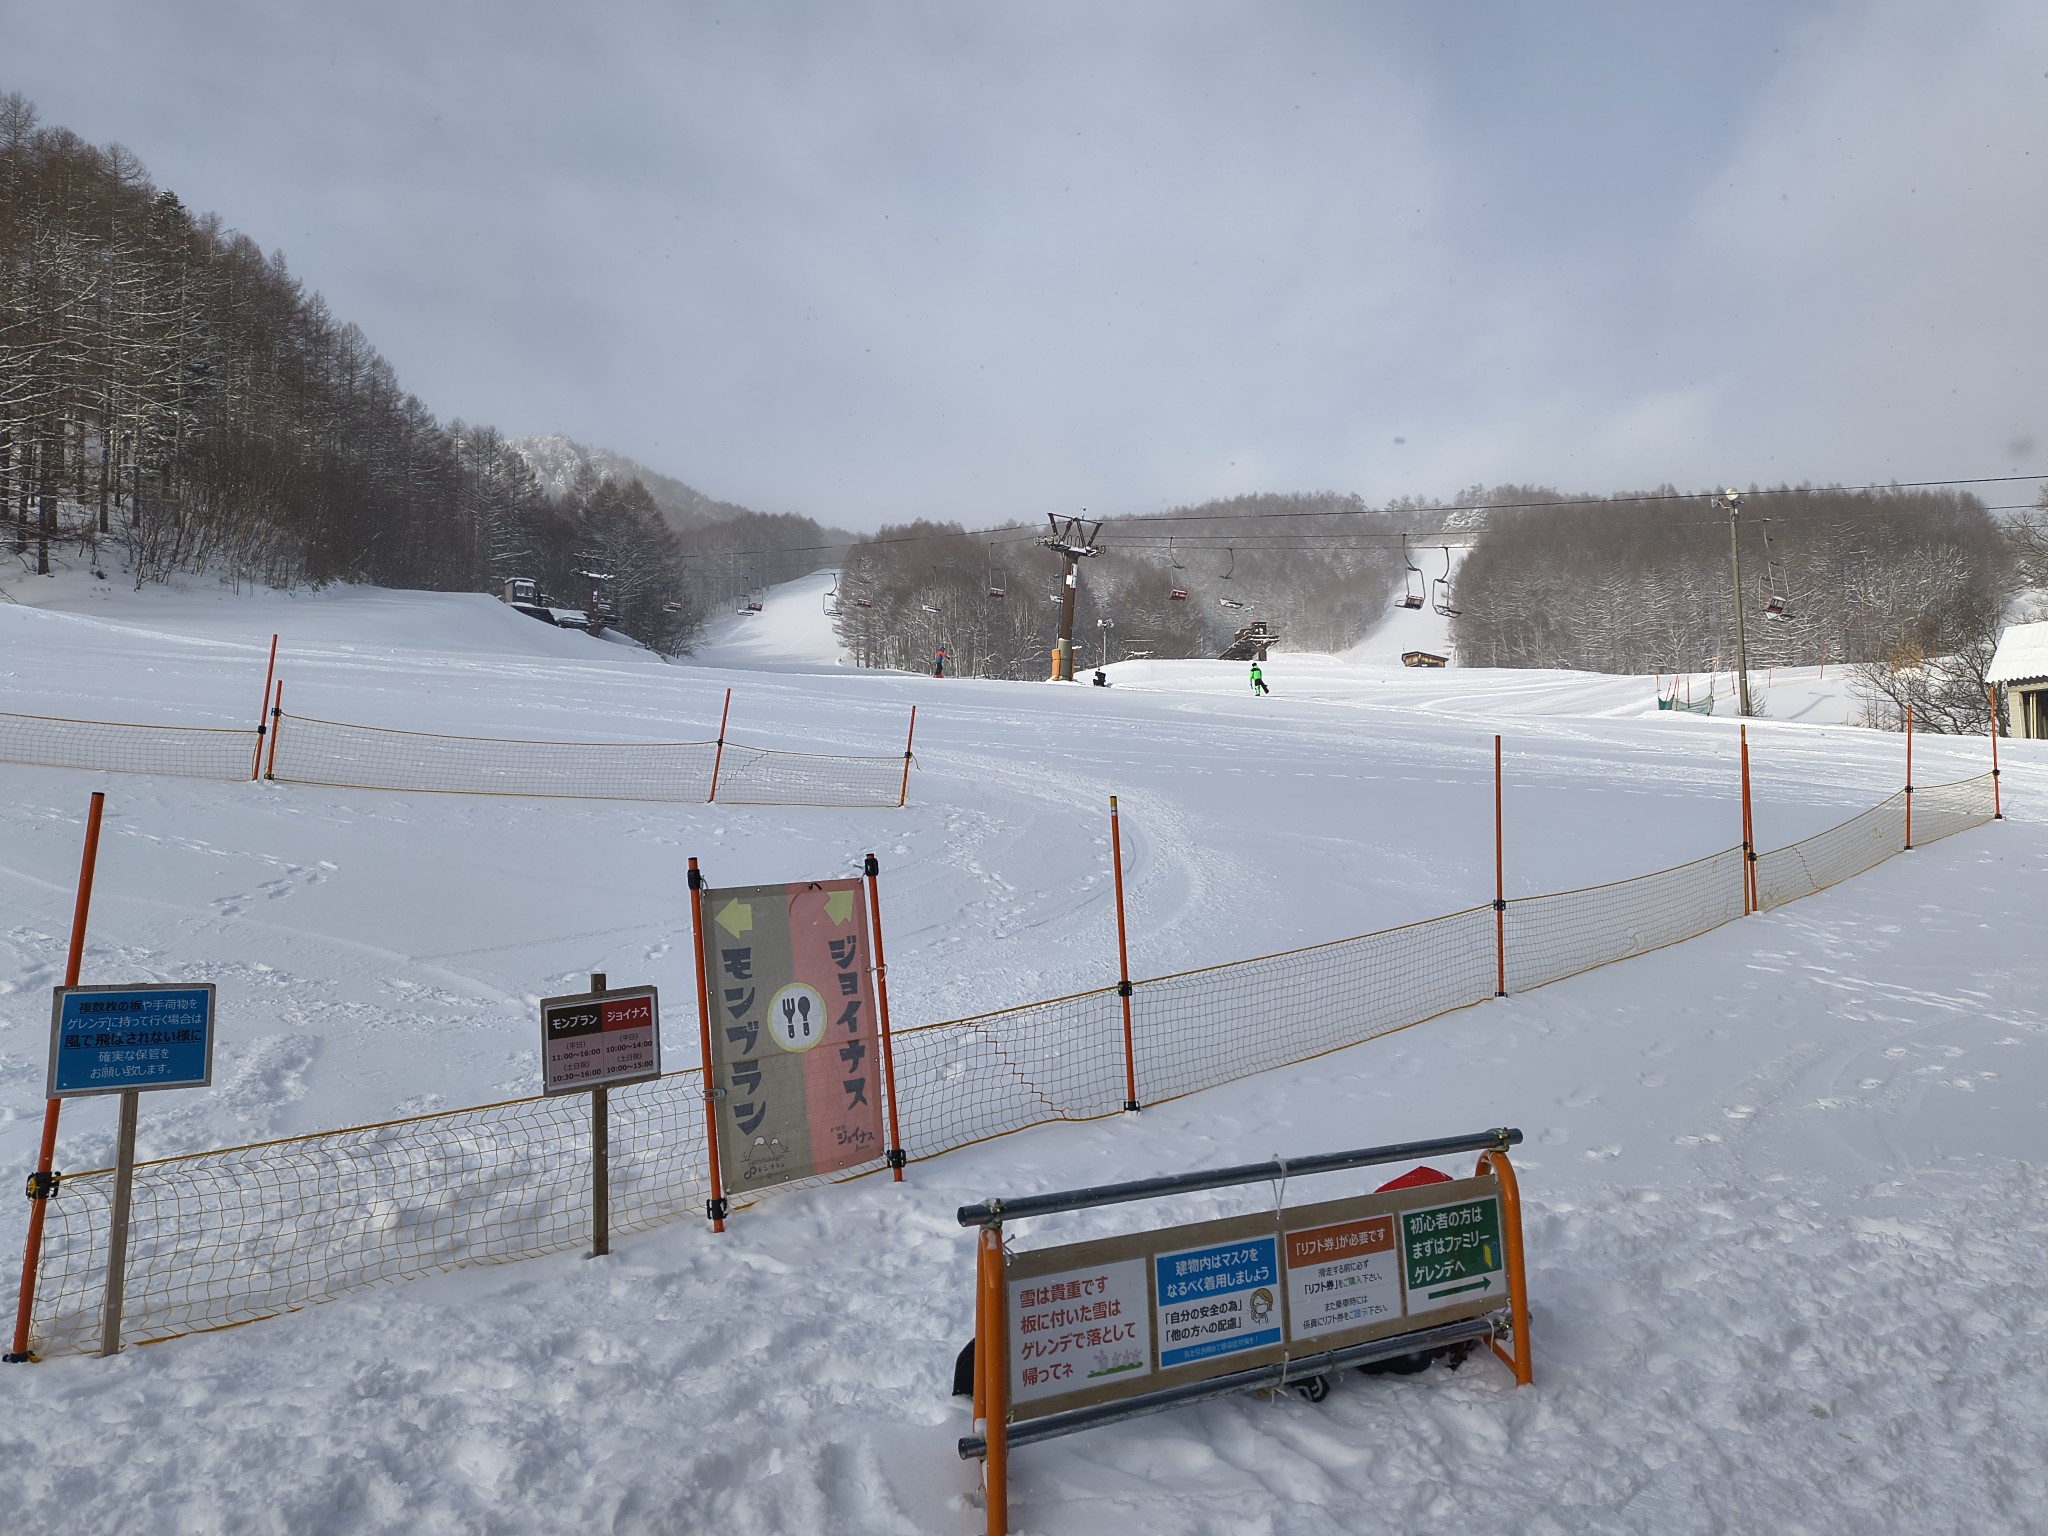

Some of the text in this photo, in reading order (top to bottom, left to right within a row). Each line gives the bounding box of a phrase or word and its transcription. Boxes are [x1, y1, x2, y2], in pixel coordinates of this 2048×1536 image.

[79, 999, 198, 1012] 複数枚の板や手荷物を
[607, 1007, 649, 1022] ジョイナス
[67, 1014, 202, 1030] ゲレンデに持って行く場合は
[552, 1014, 598, 1030] モンブラン
[828, 935, 868, 1111] ジョイナス
[65, 1029, 202, 1048] 風で飛ばされない様に
[721, 947, 766, 1135] モンブラン
[99, 1049, 169, 1062] 確実な保管を
[90, 1064, 172, 1079] お願い致します。
[1410, 1207, 1483, 1235] 初心者の方は
[1296, 1228, 1385, 1256] 「リフト券」が必要です
[1412, 1232, 1490, 1260] まずはファミリー
[1175, 1248, 1258, 1277] 建物内はマスクを
[1414, 1260, 1466, 1284] ゲレンデへ
[1019, 1275, 1108, 1309] 雪は貴重です
[1167, 1266, 1269, 1298] なるべく着用しましょう
[1021, 1299, 1121, 1335] 板に付いた雪は
[1165, 1299, 1242, 1325] 「自分の安全の為」
[1021, 1322, 1136, 1361] ゲレンデで落として
[1166, 1317, 1242, 1342] 「他の方への配慮」
[1022, 1363, 1074, 1388] 帰ってネ
